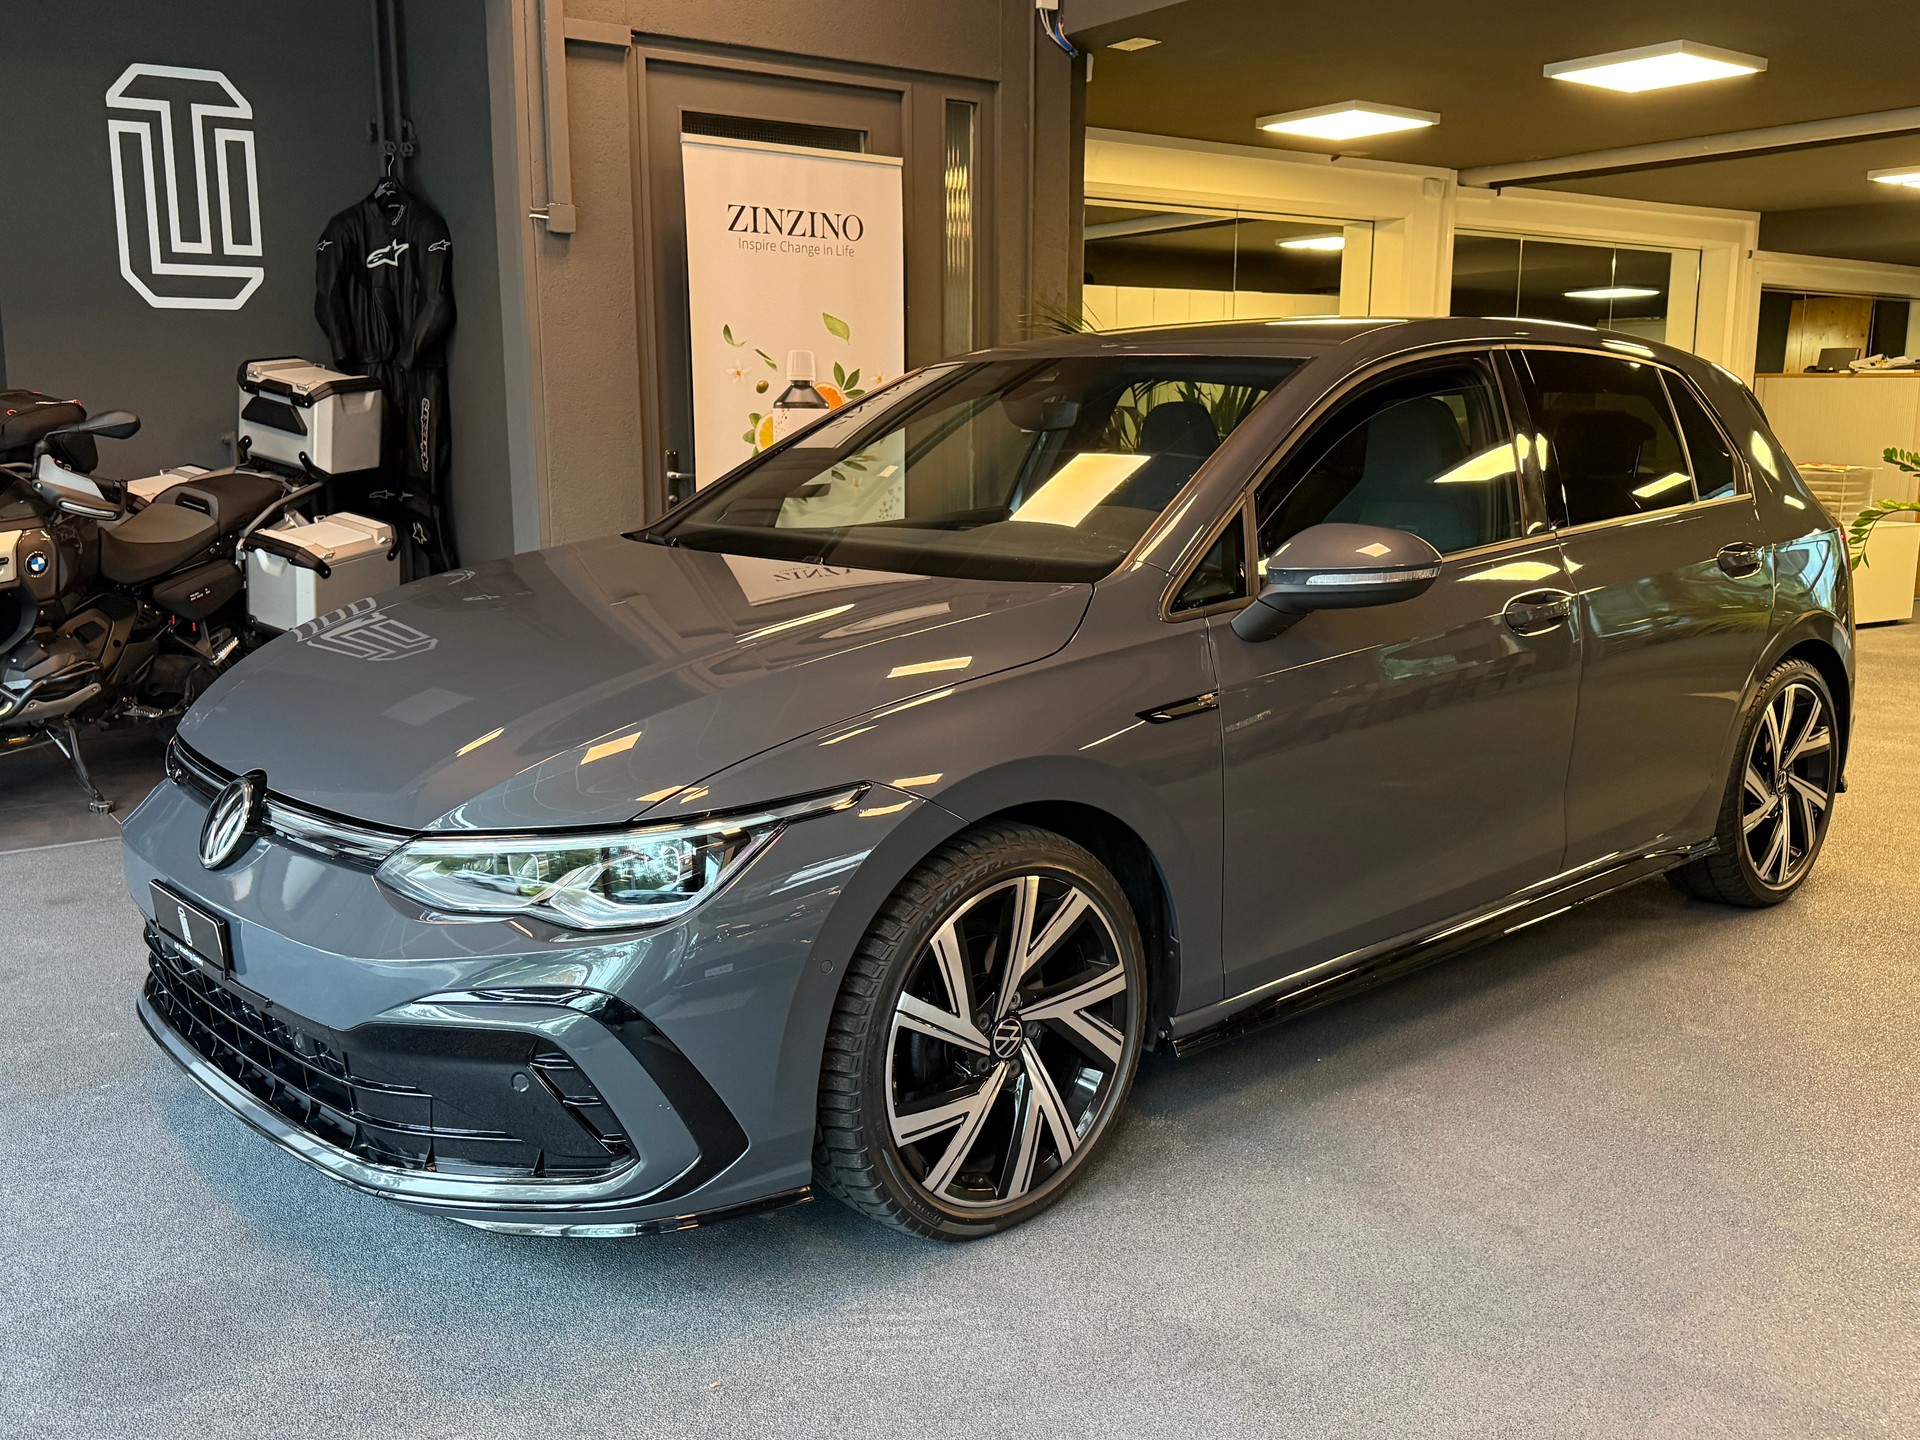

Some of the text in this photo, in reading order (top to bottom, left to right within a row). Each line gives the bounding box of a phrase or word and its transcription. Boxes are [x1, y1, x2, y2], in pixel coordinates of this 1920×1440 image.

[727, 203, 864, 242] ZINZINO
[738, 237, 855, 258] Inspire Change in Life
